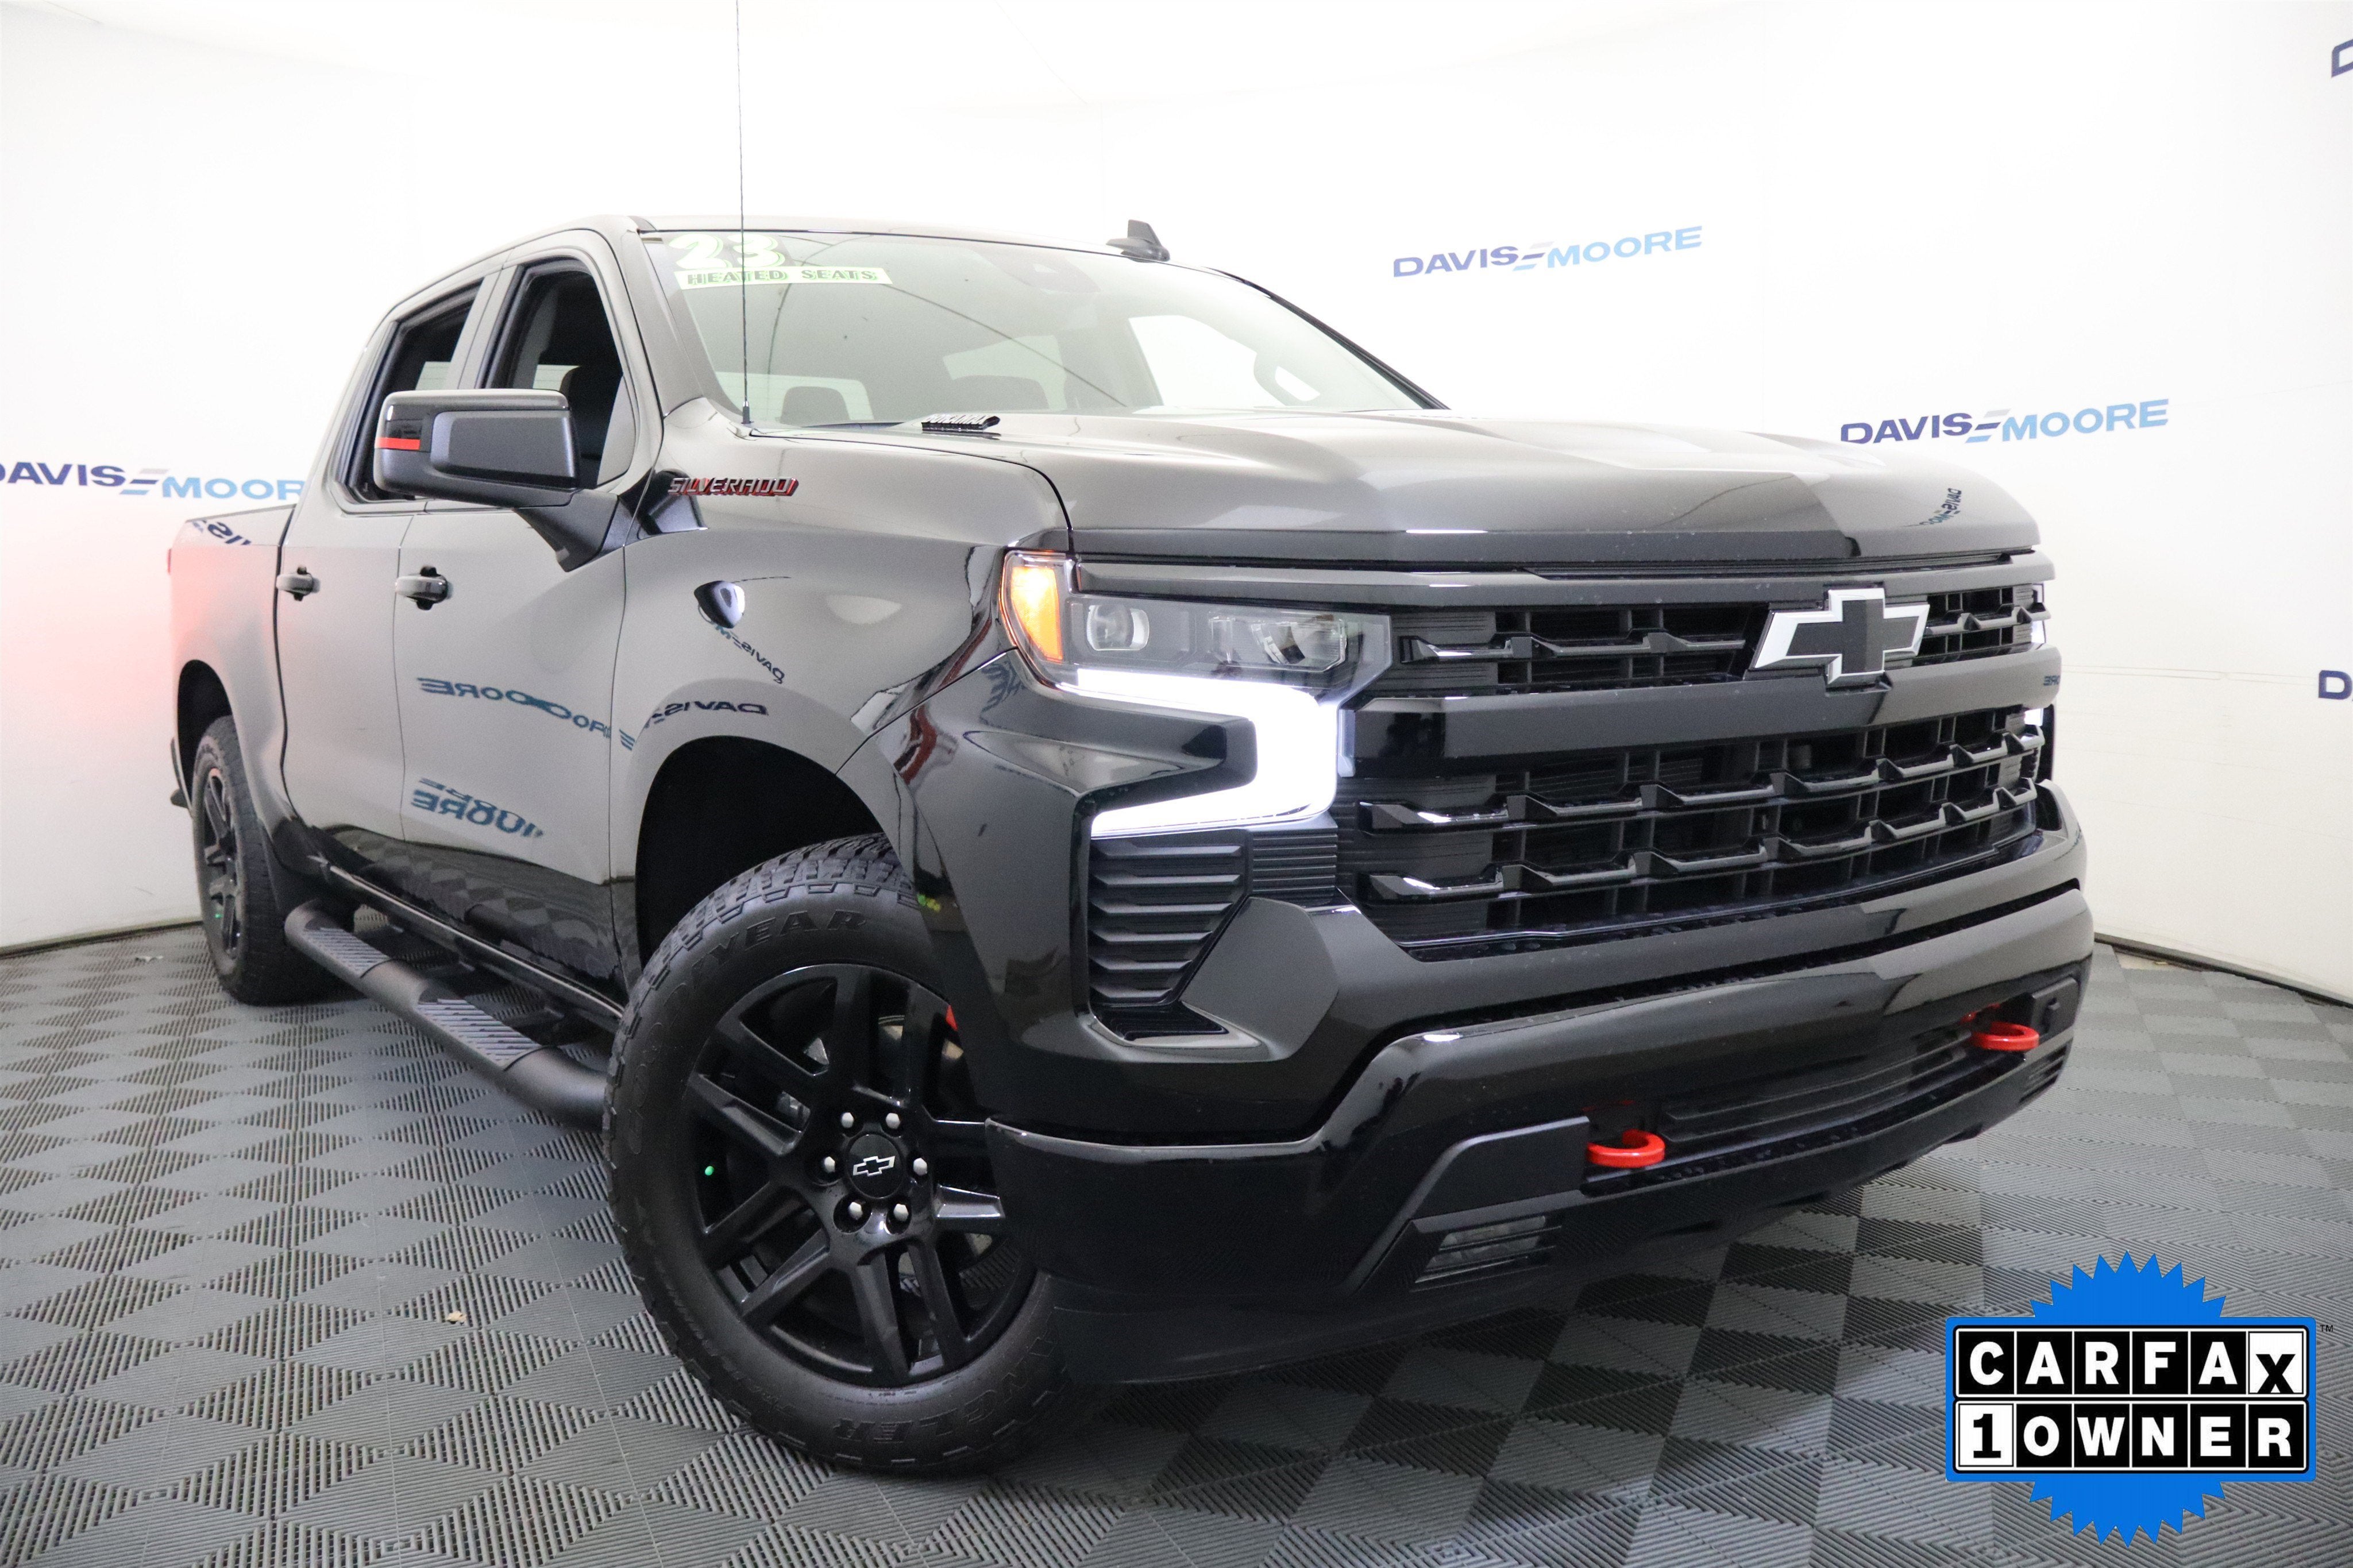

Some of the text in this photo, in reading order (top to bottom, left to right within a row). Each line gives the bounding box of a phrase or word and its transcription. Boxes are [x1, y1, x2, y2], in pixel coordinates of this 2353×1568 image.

[668, 233, 785, 269] 23
[1393, 225, 1703, 277] DAVIS MOORE
[687, 269, 878, 285] HEATED SEATS
[1840, 398, 2169, 444] DAVIS MOORE
[0, 461, 306, 500] AVIS MOOR
[668, 477, 799, 496] SILVERADO
